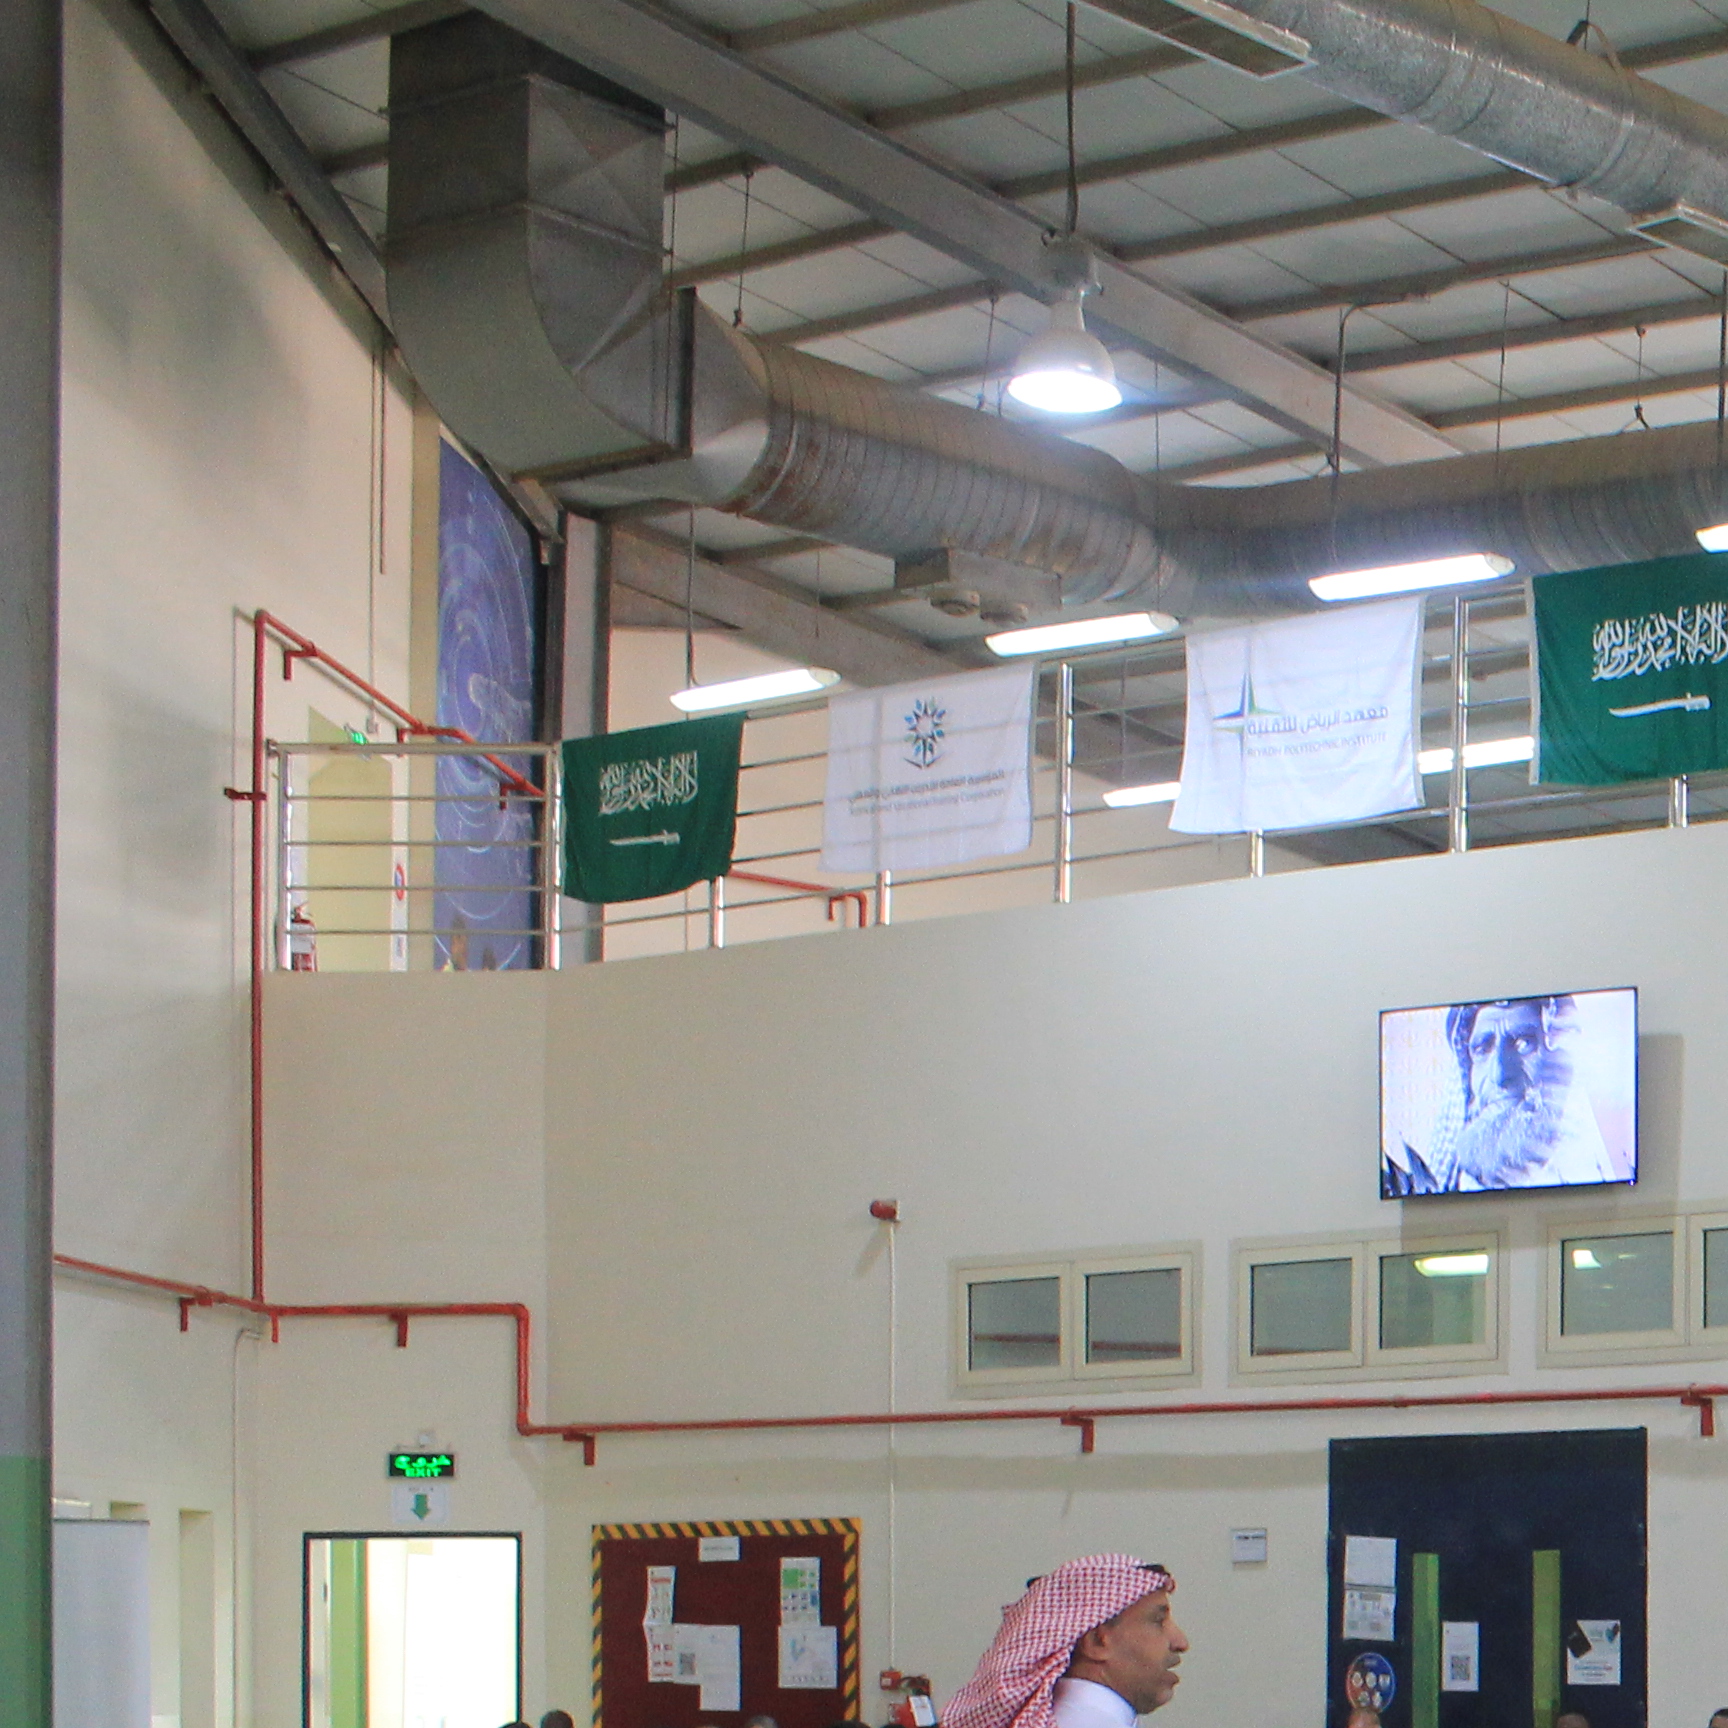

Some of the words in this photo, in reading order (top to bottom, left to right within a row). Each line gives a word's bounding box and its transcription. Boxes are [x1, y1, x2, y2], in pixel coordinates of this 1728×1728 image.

[1300, 710, 1342, 734] الرياض
[1344, 705, 1389, 723] معهد
[1341, 731, 1388, 750] INSTITUTE
[394, 1454, 452, 1470] خروج
[405, 1467, 442, 1477] EXIT
